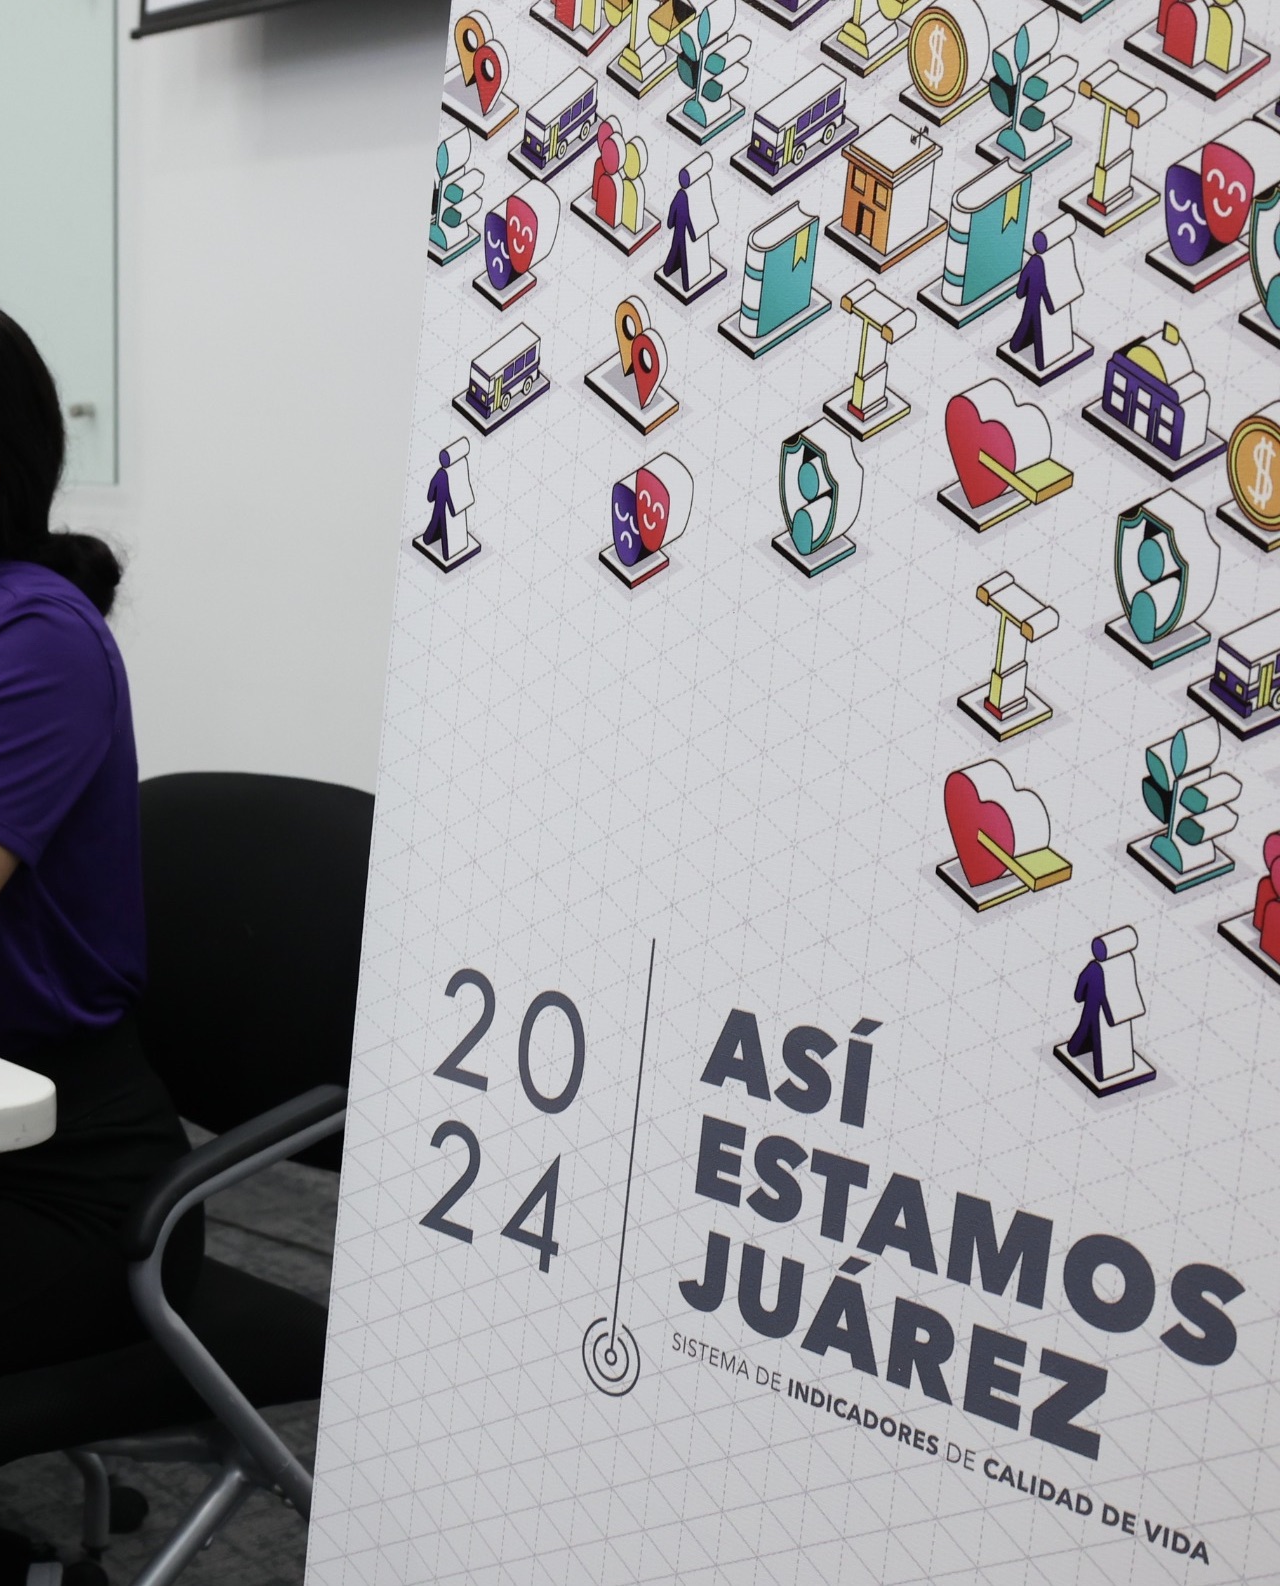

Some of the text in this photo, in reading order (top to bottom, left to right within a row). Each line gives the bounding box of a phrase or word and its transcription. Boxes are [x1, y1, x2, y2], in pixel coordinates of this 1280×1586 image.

[433, 968, 586, 1115] 20
[699, 1008, 884, 1129] ASÍ
[418, 1120, 561, 1274] 24
[694, 1114, 1246, 1367] ESTAMOS
[678, 1230, 1109, 1462] JUÁREZ
[672, 1332, 1210, 1566] SISTEMA DE INDICADORES DE CALIDAD DE VIDA
